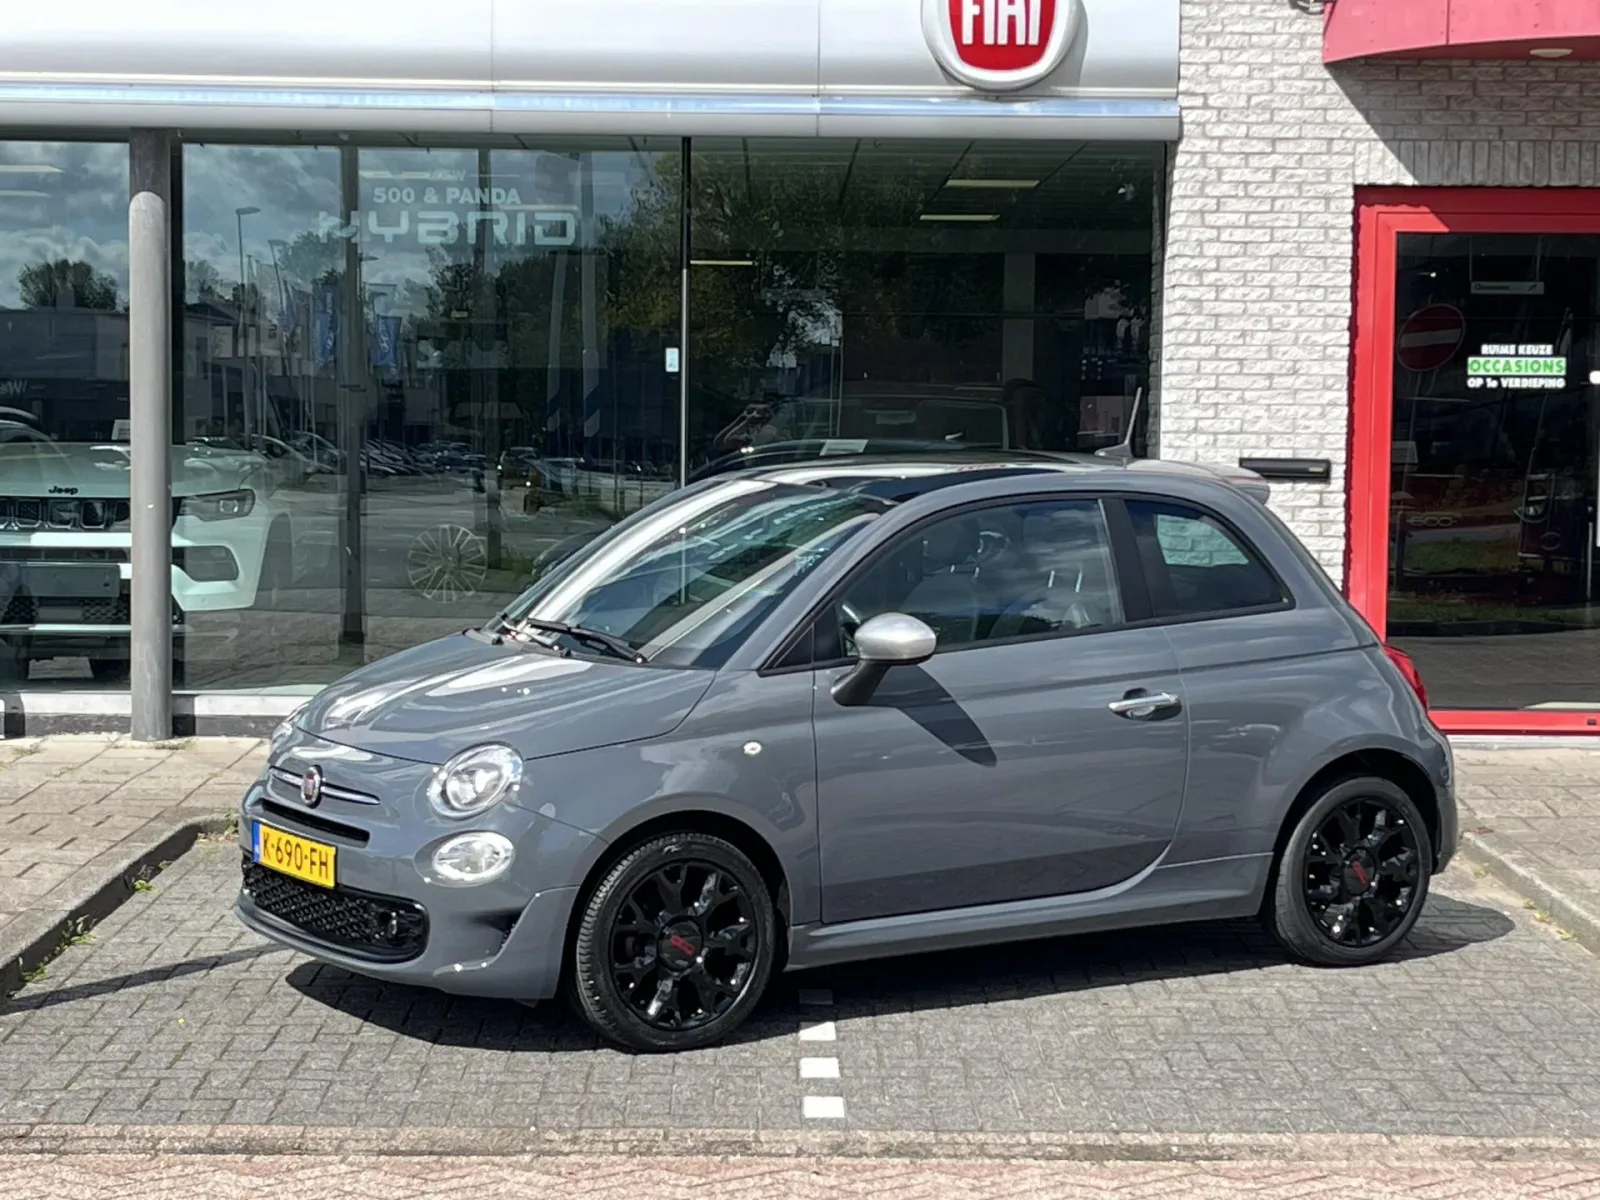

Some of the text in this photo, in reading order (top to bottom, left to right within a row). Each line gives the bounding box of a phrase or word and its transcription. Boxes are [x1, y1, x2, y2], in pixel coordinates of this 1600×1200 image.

[373, 187, 521, 204] 500 & PANDA
[318, 211, 576, 246] HYBRID
[1518, 344, 1553, 355] KEUZE
[1469, 360, 1564, 372] OCCASIONS
[1467, 377, 1484, 388] OP
[1501, 377, 1566, 388] VERDIEPING
[48, 485, 78, 495] Jeep
[263, 832, 328, 879] K-690-FH
